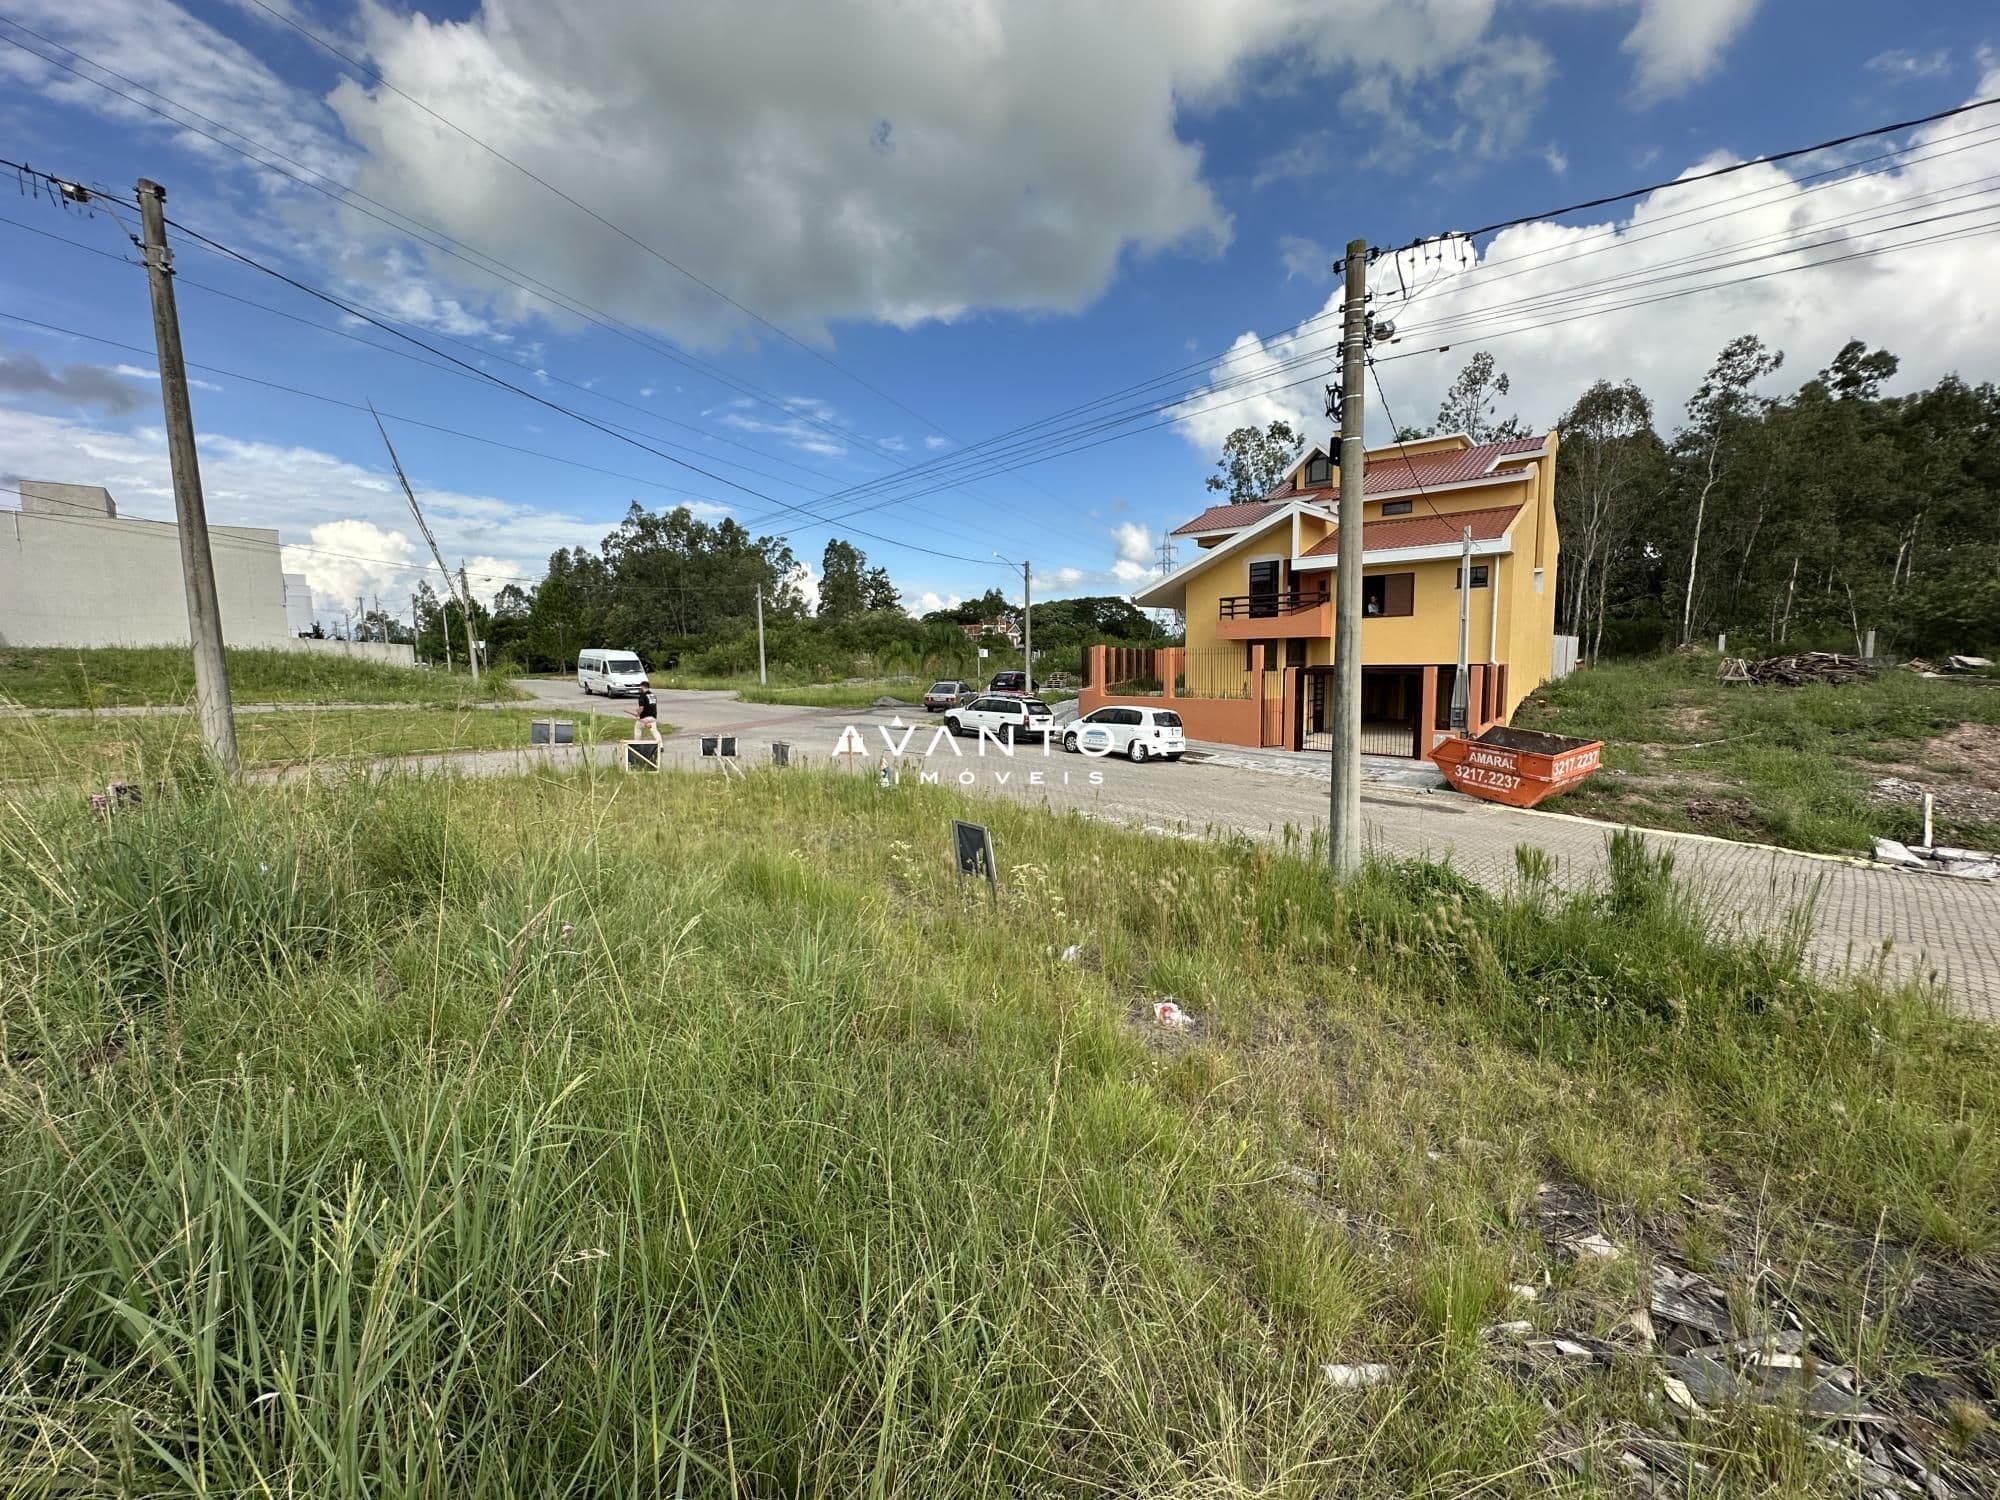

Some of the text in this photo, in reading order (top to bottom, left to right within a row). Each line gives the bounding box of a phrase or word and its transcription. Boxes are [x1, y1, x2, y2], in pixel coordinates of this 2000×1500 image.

[1469, 751, 1516, 770] AMARAL
[1552, 750, 1600, 777] 3217.2237
[1455, 764, 1520, 790] 3217.2237
